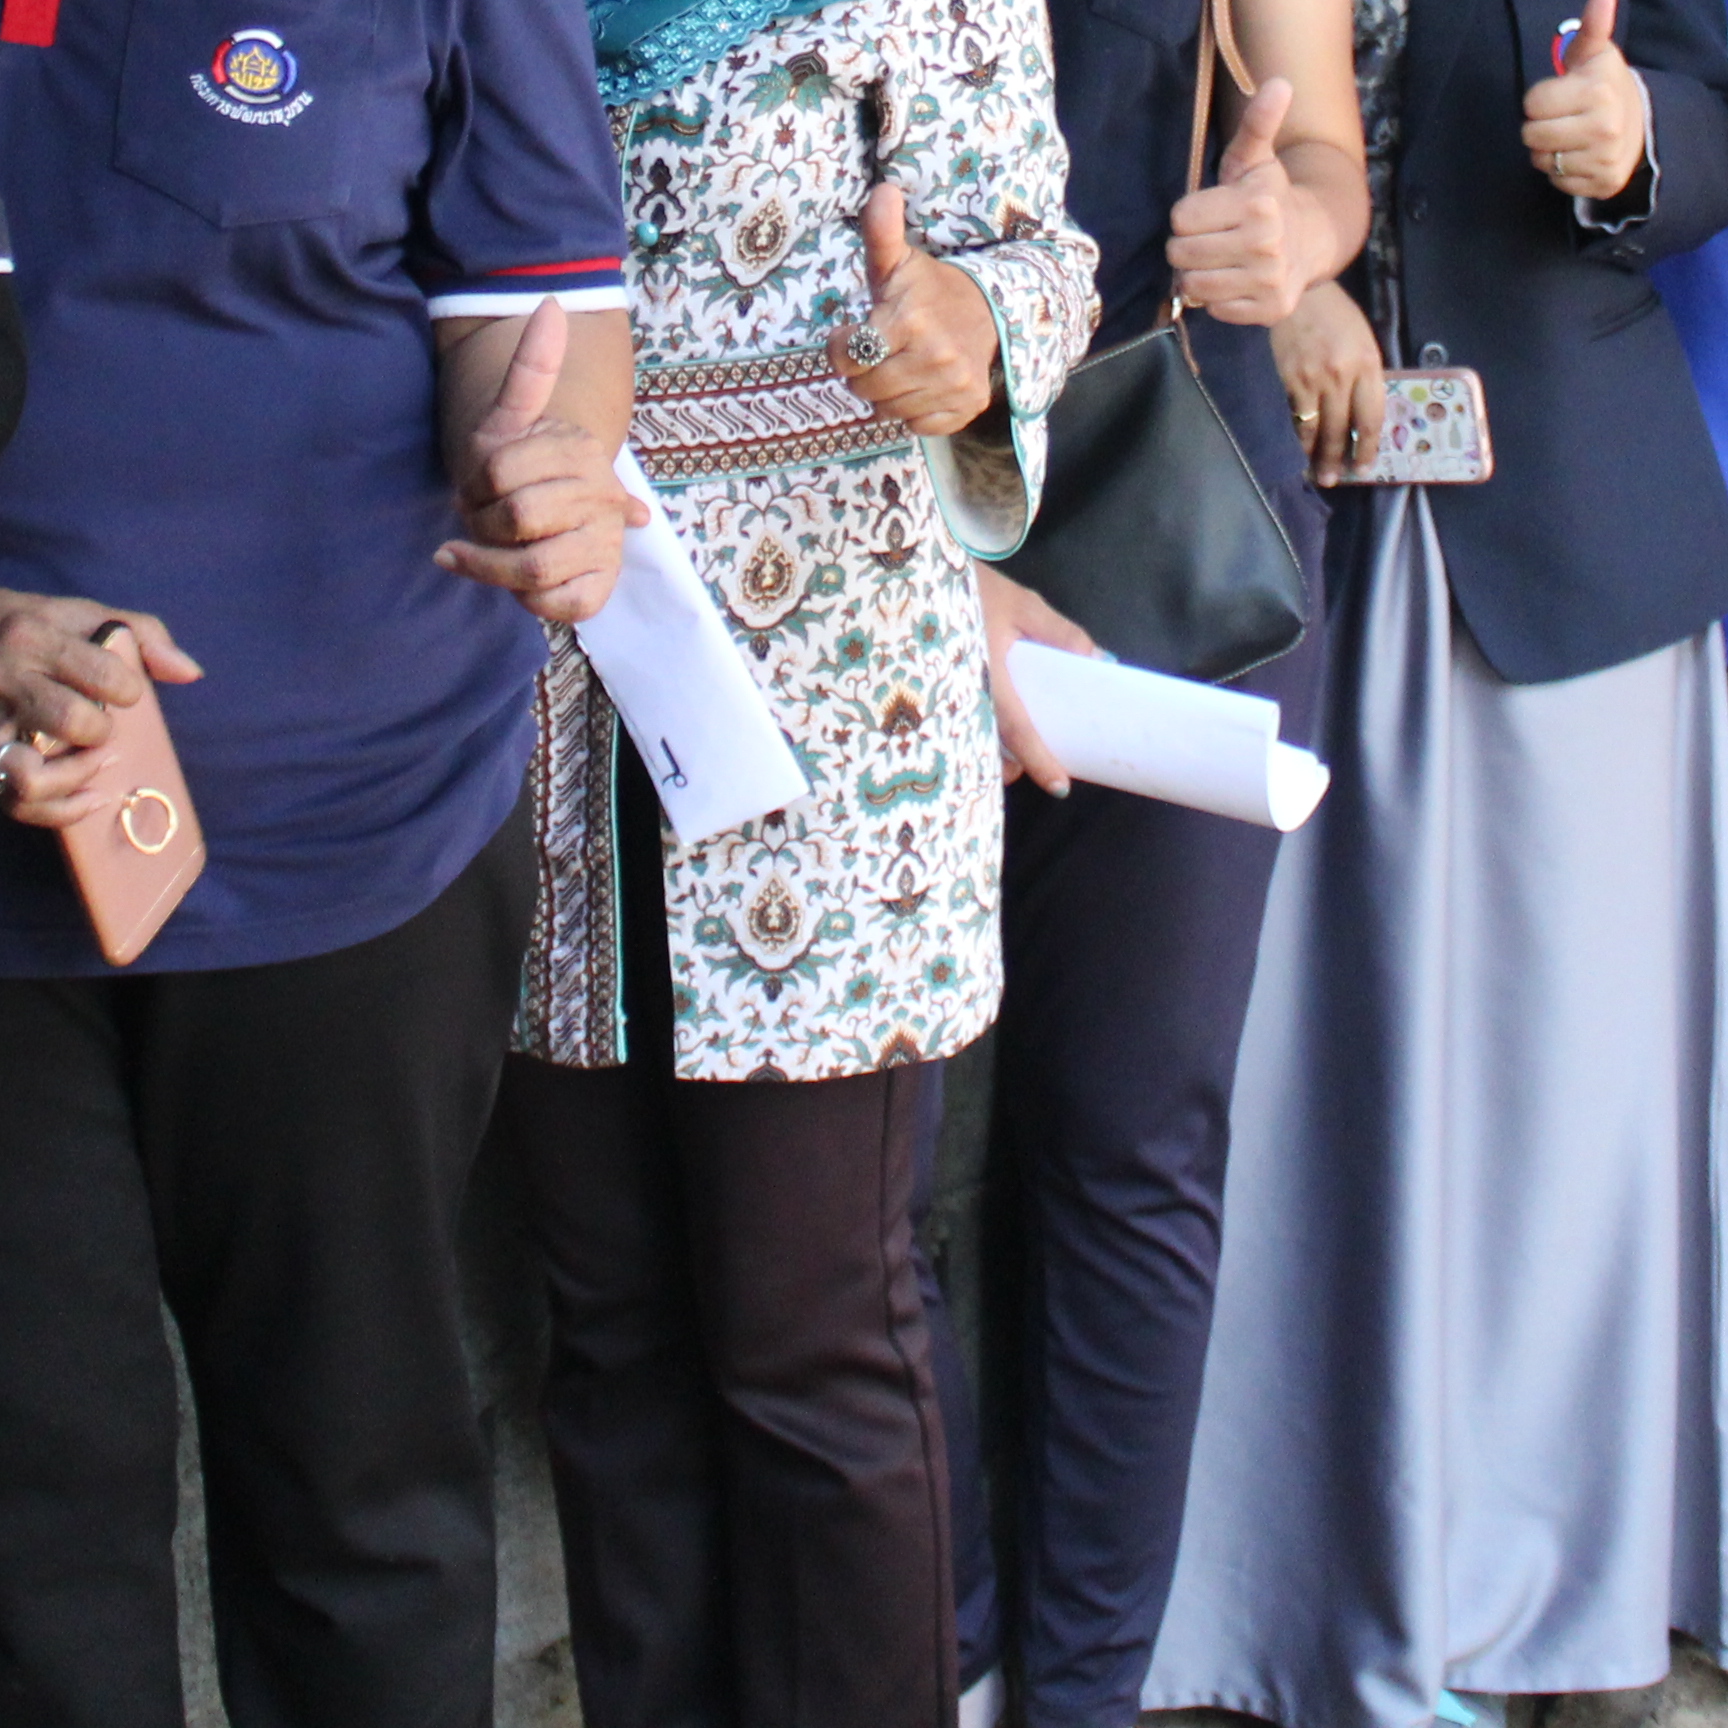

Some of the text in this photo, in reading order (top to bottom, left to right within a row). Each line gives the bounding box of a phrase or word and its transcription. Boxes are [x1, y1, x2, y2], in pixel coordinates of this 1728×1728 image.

[190, 73, 314, 127] กรมการพัฒนาชุมชน
